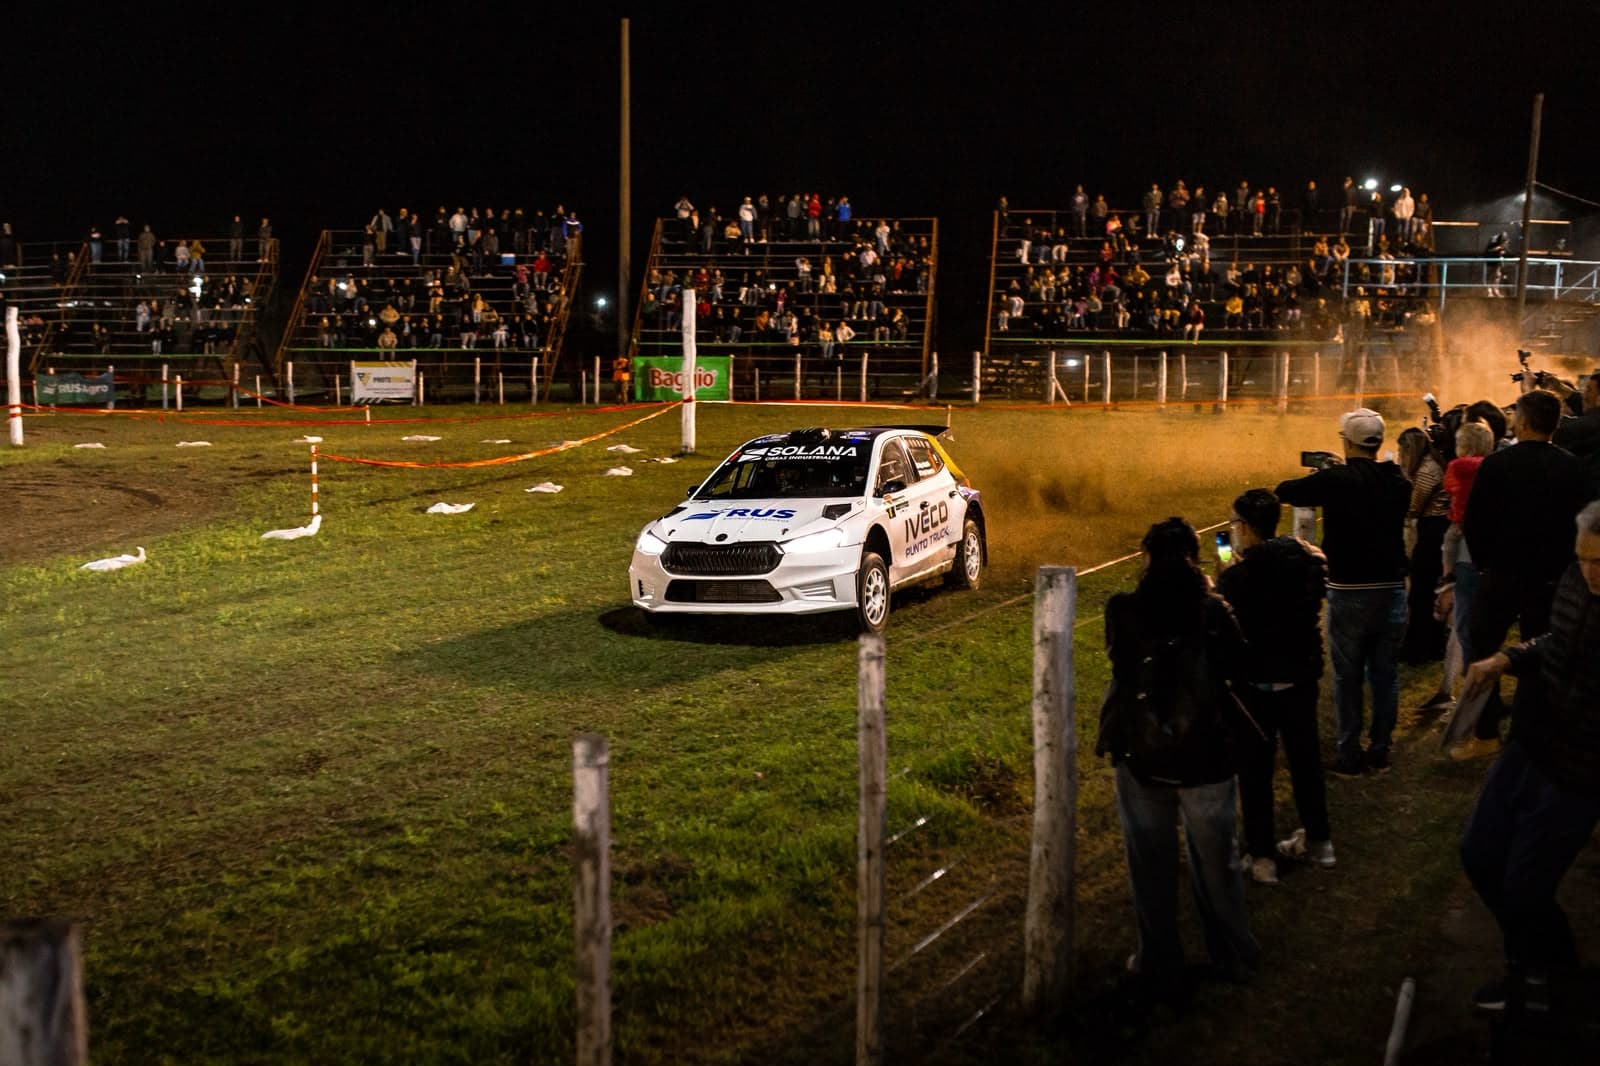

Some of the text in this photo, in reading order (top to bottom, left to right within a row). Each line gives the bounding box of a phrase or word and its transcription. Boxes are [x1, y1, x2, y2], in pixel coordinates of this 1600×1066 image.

[649, 367, 717, 392] Bagio
[767, 445, 857, 457] SOLANA
[726, 508, 797, 519] RUS
[905, 500, 948, 543] IVECO
[905, 526, 950, 558] PUNTO TRUCK
